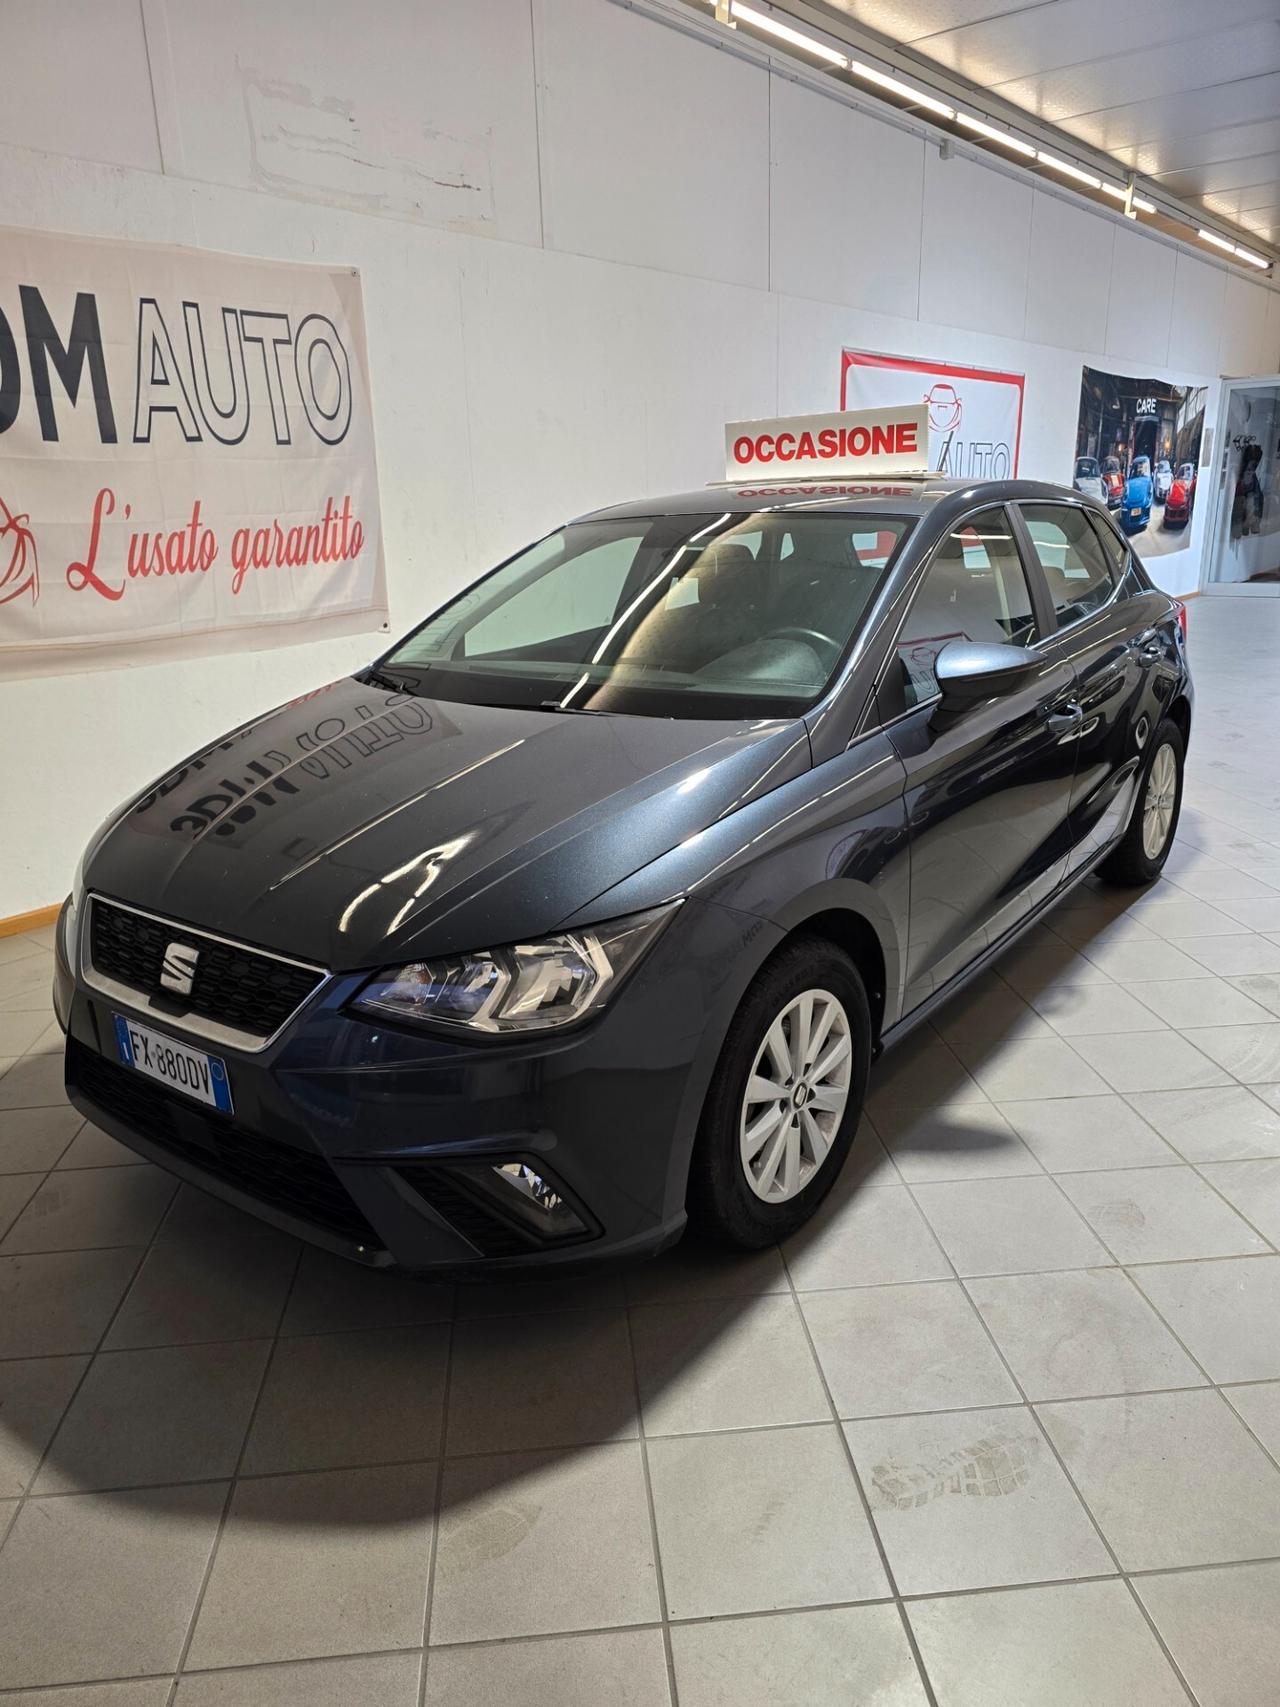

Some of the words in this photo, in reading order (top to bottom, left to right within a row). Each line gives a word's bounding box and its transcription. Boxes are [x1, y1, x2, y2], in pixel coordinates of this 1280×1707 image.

[133, 297, 352, 446] AUTO
[733, 422, 918, 464] OCCASIONE
[936, 441, 1011, 479] AUTO
[66, 488, 218, 601] L'usato
[231, 496, 364, 594] garantito
